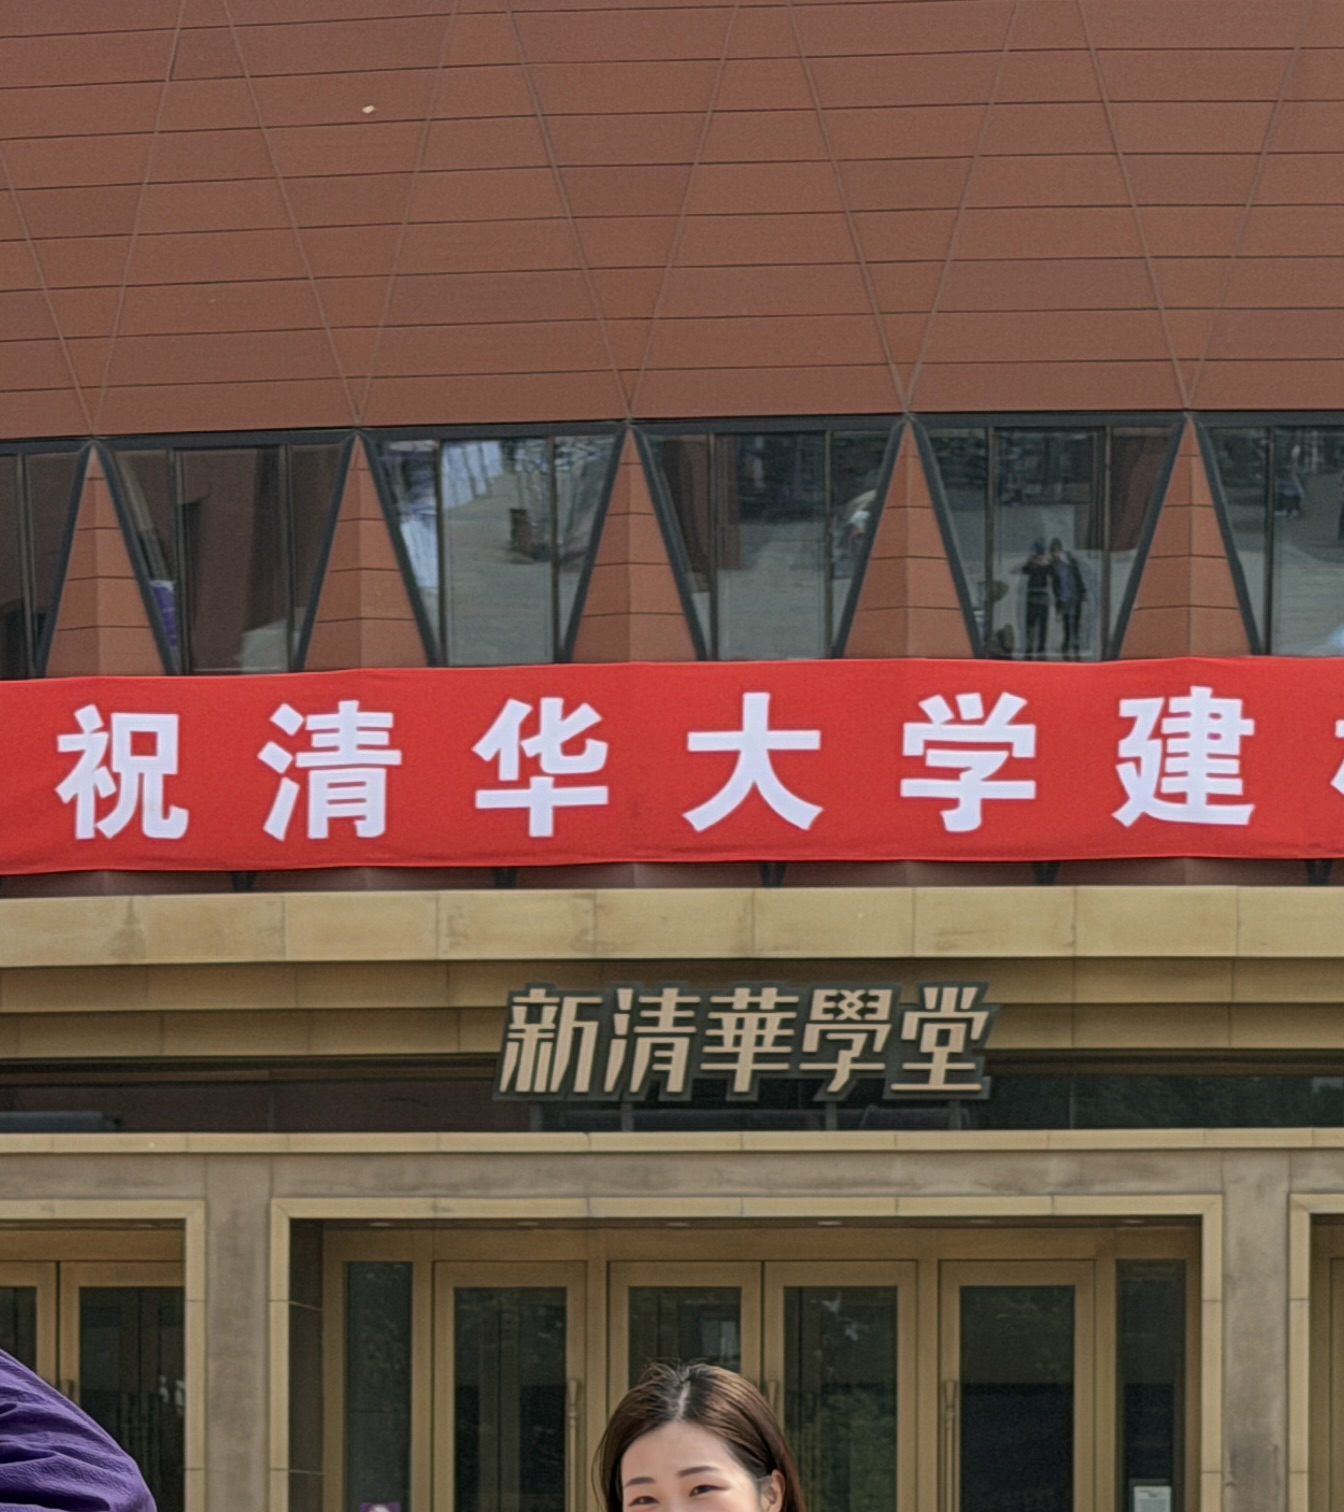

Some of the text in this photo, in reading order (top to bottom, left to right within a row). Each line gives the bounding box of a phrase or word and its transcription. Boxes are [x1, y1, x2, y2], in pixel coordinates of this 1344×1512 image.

[498, 985, 991, 1094] 新清華學堂
